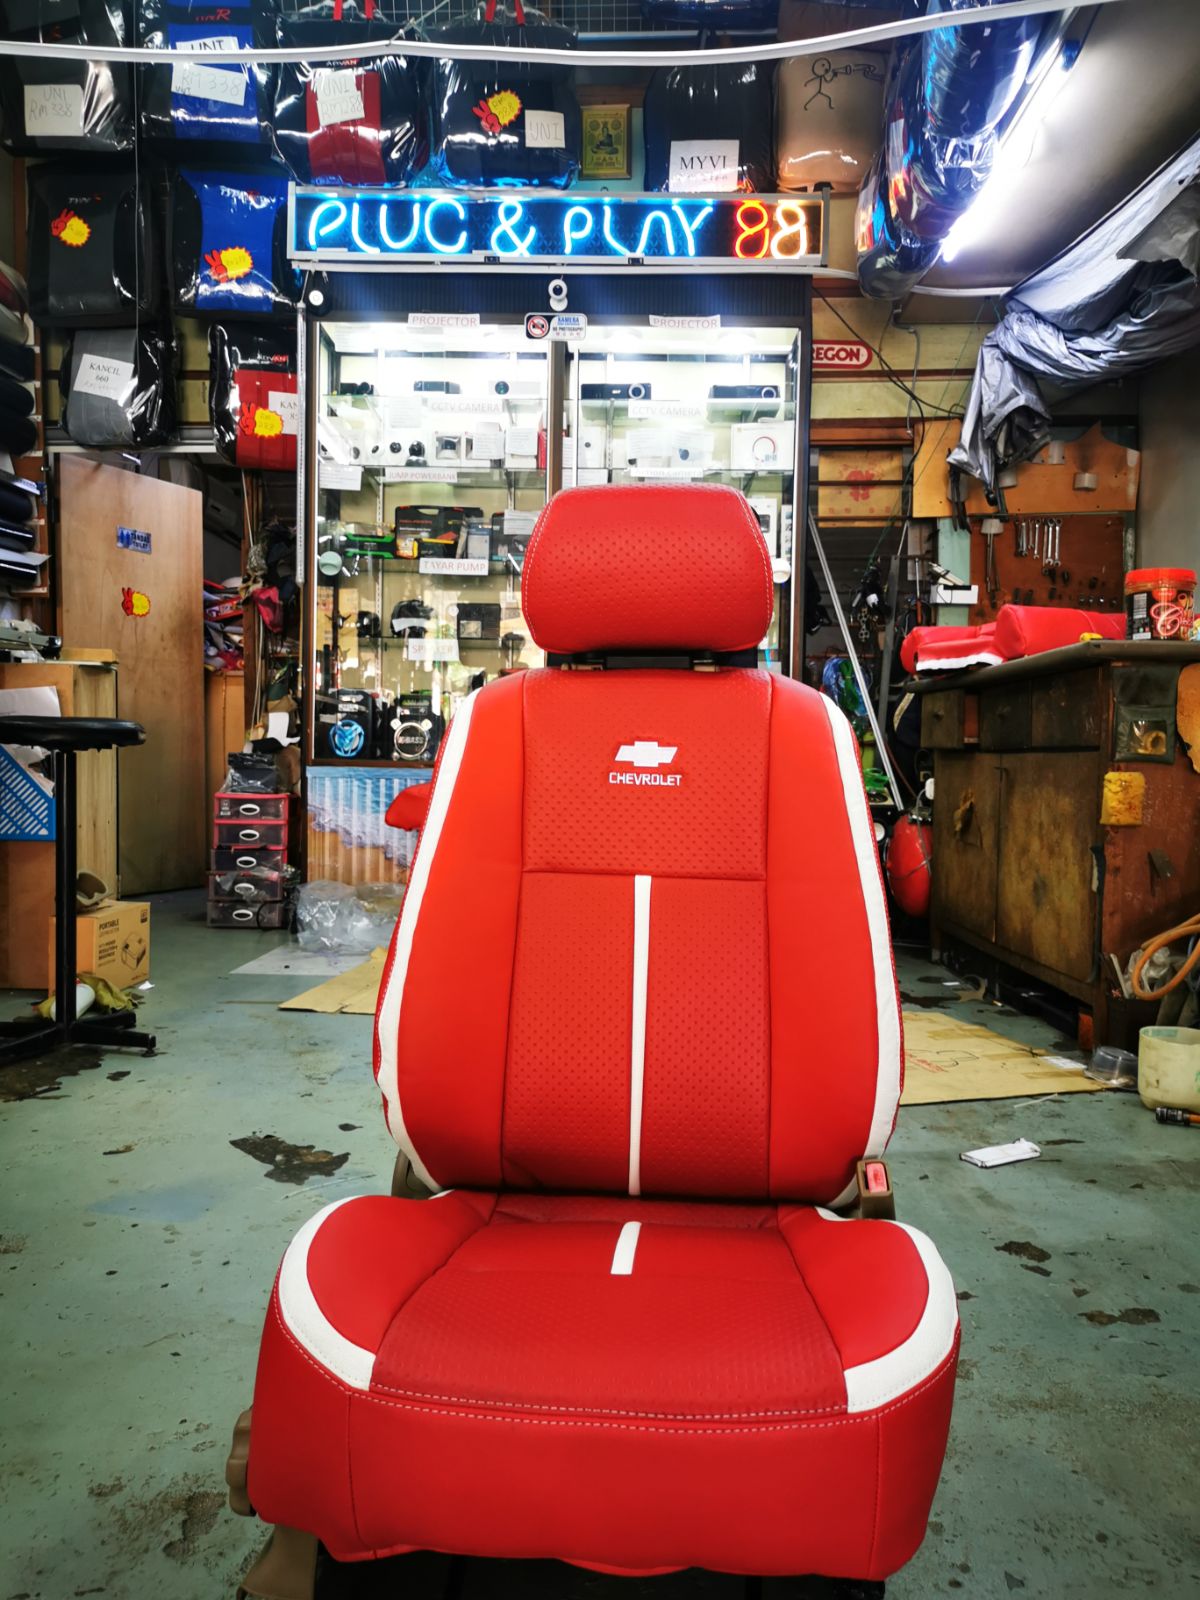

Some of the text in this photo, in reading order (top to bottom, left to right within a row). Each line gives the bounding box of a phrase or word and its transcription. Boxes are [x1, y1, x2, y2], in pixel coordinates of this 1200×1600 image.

[529, 121, 561, 141] UNI
[679, 155, 727, 170] MYVI
[489, 199, 537, 257] &
[735, 201, 809, 260] 88
[411, 315, 478, 327] PROJECTOR
[653, 317, 718, 329] PROJECTOR
[811, 346, 861, 362] EGON
[89, 362, 121, 377] KANCIL
[460, 402, 500, 413] CAMERA
[659, 406, 701, 417] CAMERA
[424, 561, 486, 572] TAYAR PUMP
[609, 772, 682, 786] CHEVROLET
